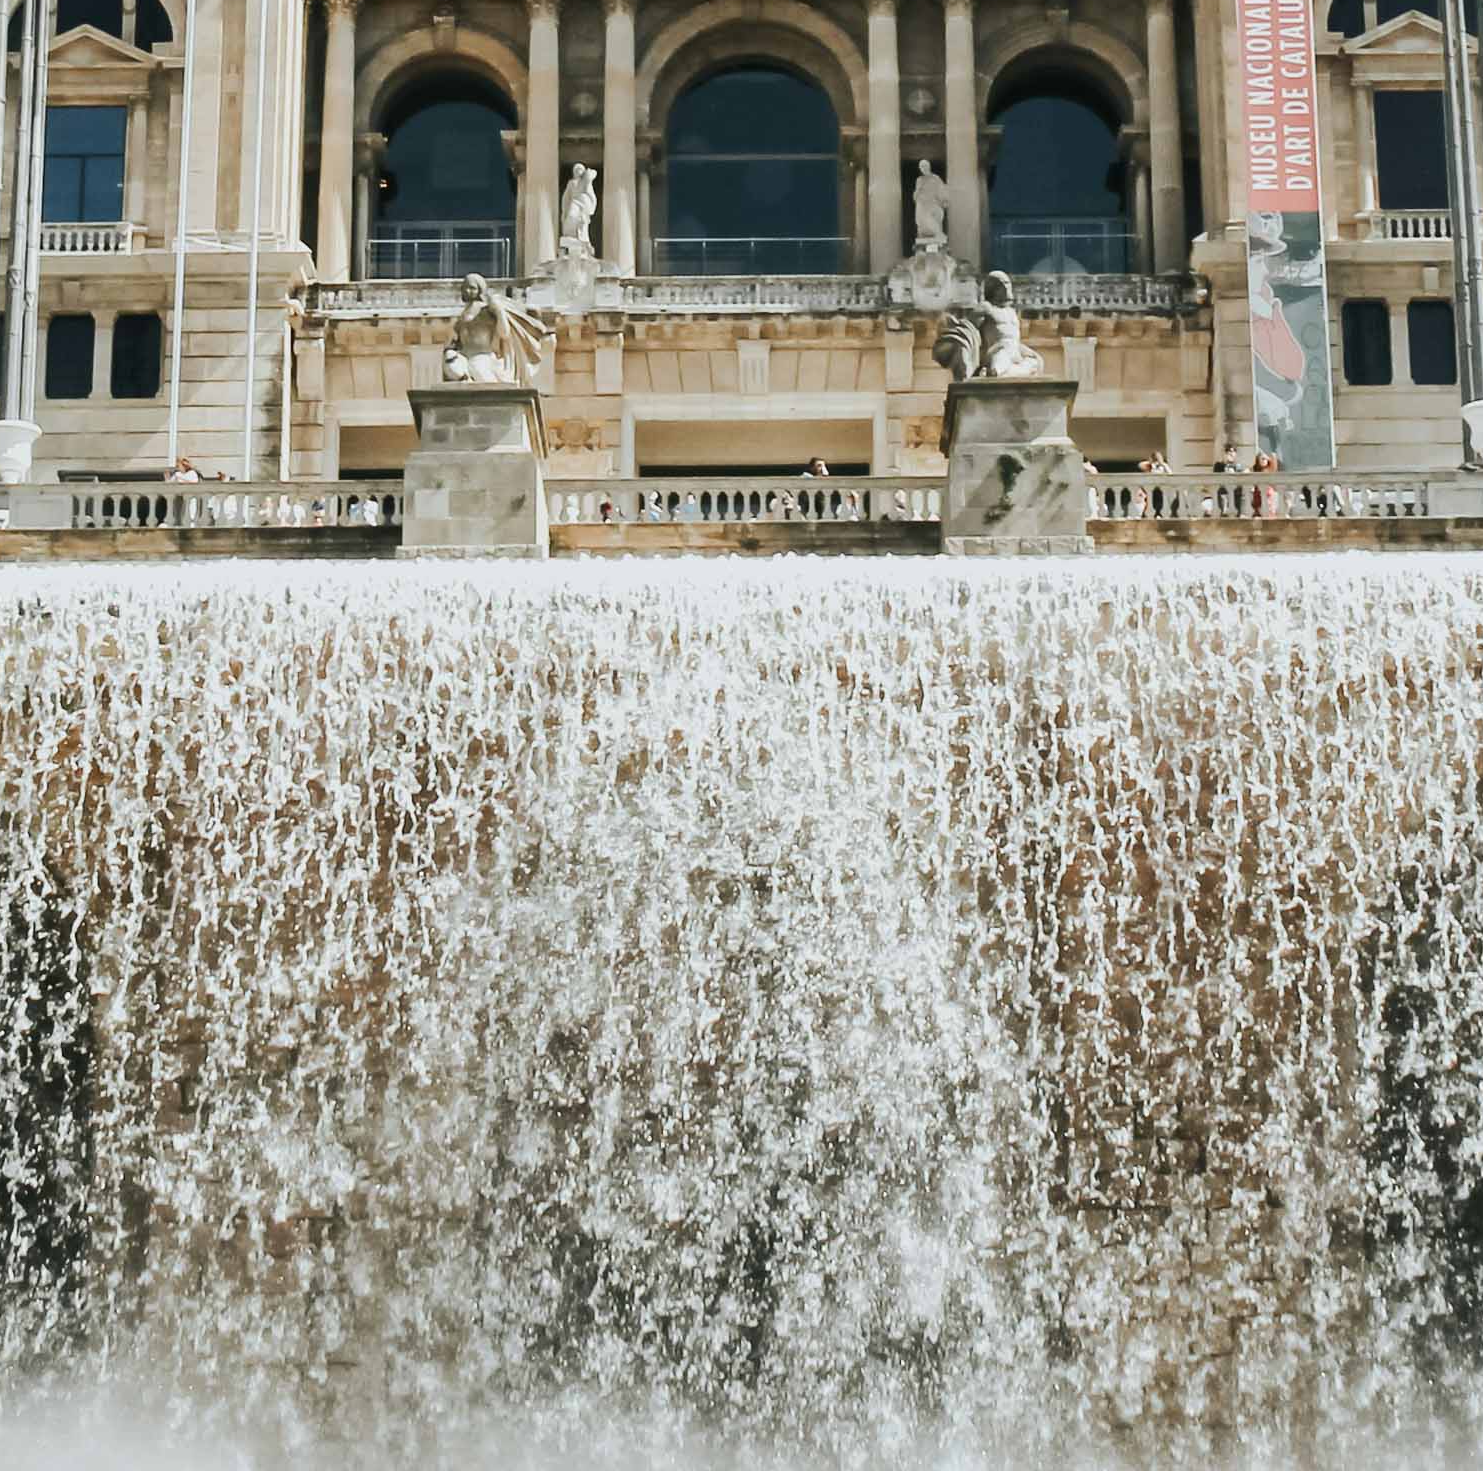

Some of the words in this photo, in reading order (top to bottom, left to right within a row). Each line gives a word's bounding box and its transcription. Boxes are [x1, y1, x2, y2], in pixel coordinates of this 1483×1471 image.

[1280, 87, 1310, 114] DE
[1248, 114, 1279, 190] MUSEU
[1282, 124, 1313, 190] D'ART
